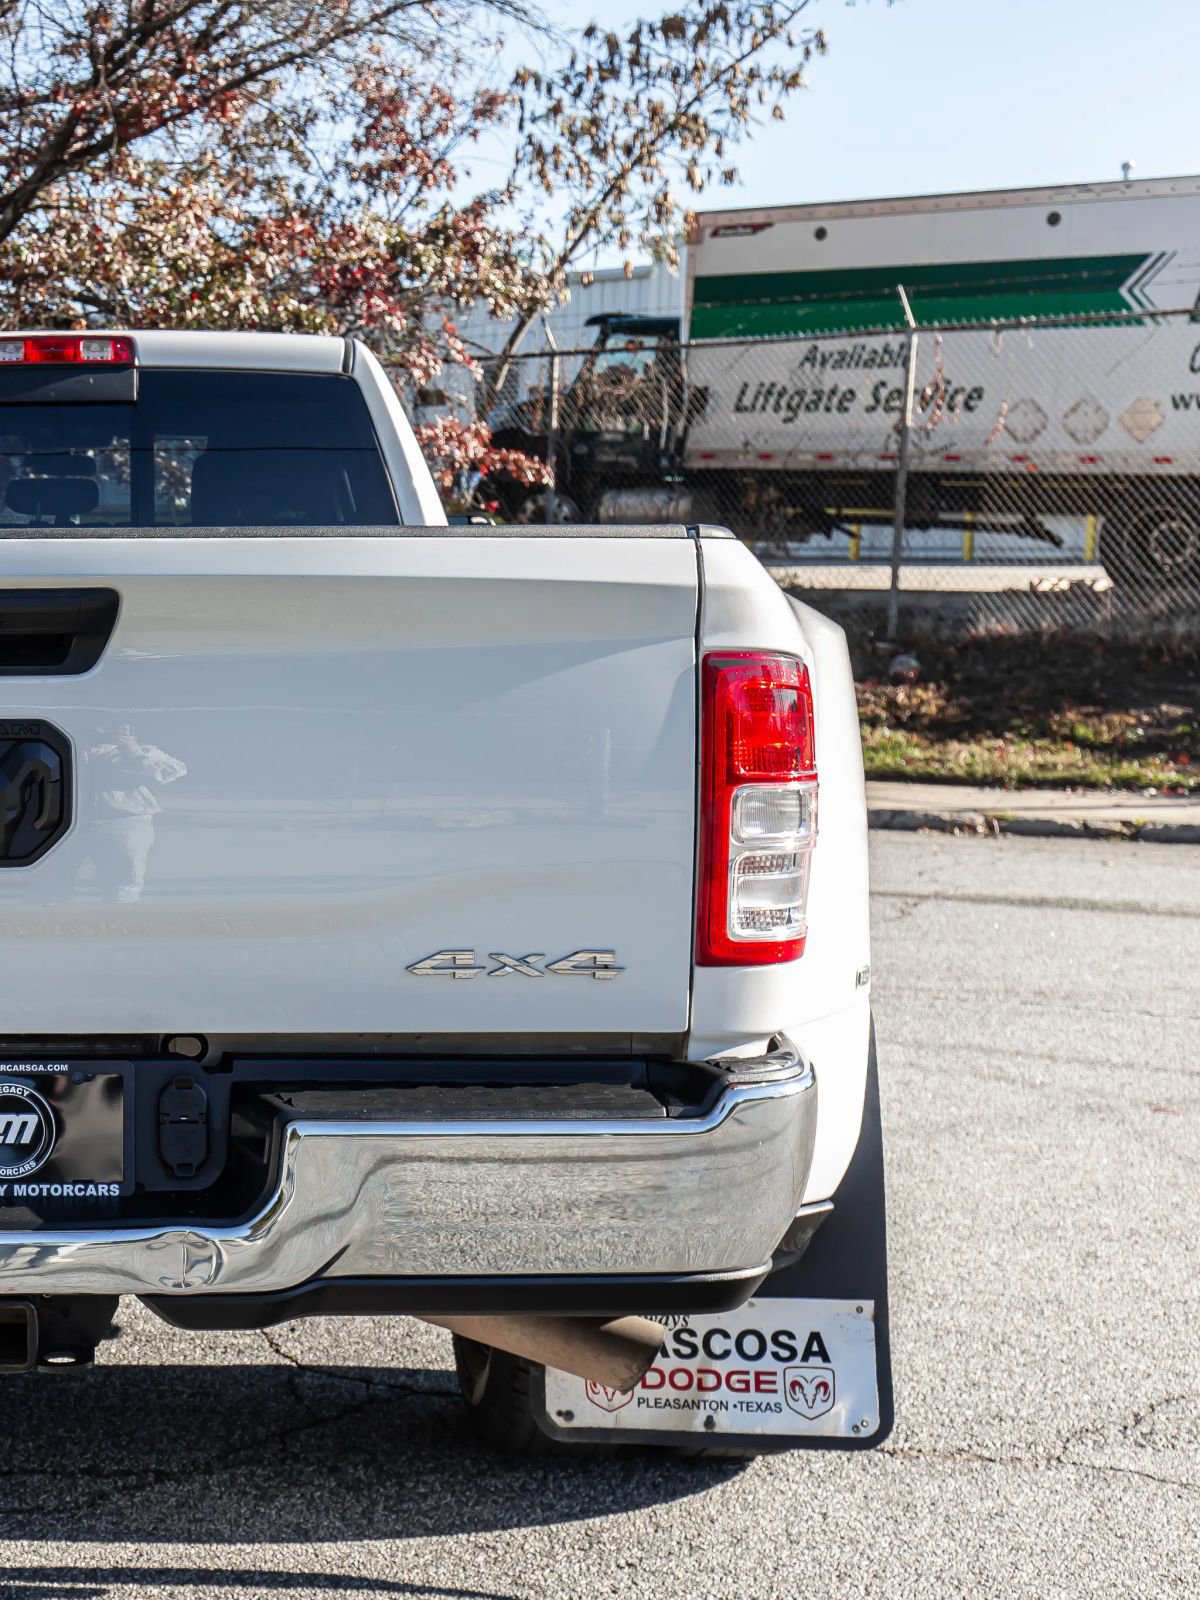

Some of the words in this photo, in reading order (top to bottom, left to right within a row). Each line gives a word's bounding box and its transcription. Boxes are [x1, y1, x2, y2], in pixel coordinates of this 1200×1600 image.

[733, 382, 857, 424] Liftgate
[13, 1184, 120, 1197] MOTORCARS
[640, 1367, 779, 1394] DODGE
[637, 1397, 729, 1412] PLEASANTON
